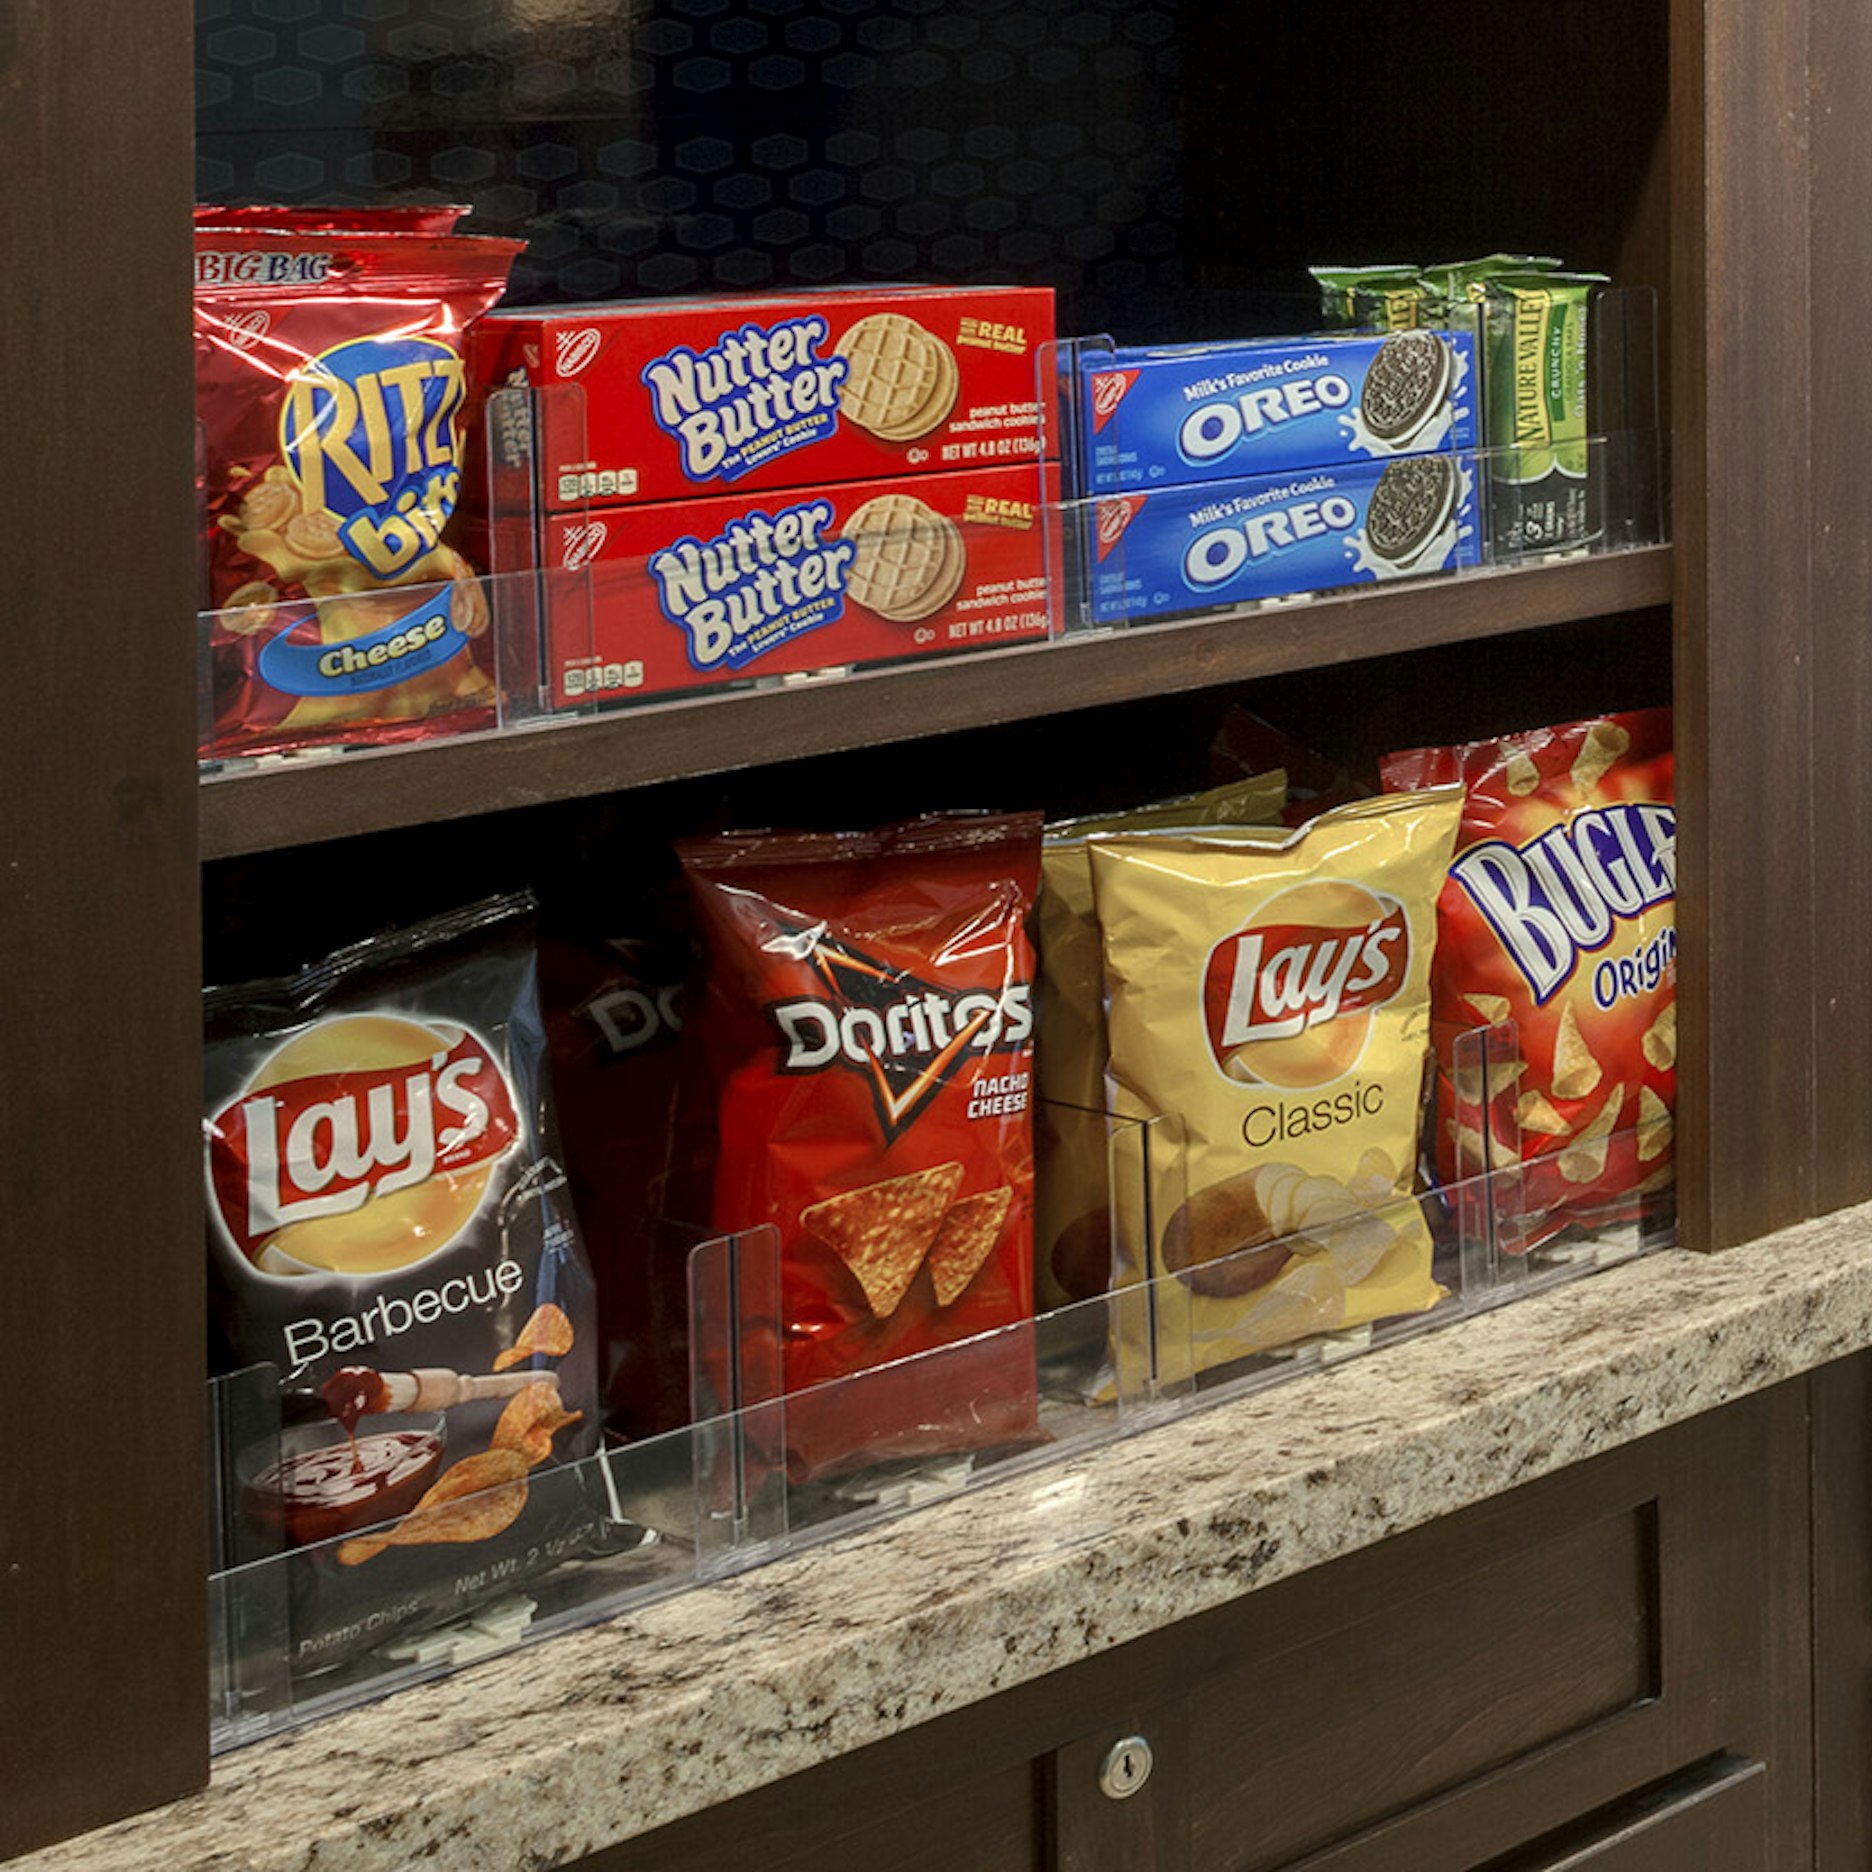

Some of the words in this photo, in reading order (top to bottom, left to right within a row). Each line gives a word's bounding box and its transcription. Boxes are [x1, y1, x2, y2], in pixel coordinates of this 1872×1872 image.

[196, 251, 264, 284] BIG
[267, 250, 332, 284] BAG
[977, 321, 1028, 346] REAL
[1517, 291, 1546, 365] VALLEY
[1550, 325, 1562, 399] CRUNCHY
[649, 319, 823, 426] Nutter
[1183, 377, 1227, 402] Milk's
[1226, 364, 1284, 388] Favorite
[1283, 353, 1329, 373] Cookie
[1516, 364, 1547, 442] NATURE
[294, 358, 467, 516] RITZ
[679, 359, 848, 480] Butter
[785, 414, 829, 435] BUTTER
[949, 418, 1002, 433] sandwich
[968, 402, 1008, 420] peanut
[1181, 374, 1351, 459] OREO
[942, 445, 960, 461] NET
[961, 443, 977, 460] WT
[984, 499, 1033, 519] REAL
[1188, 504, 1233, 528] Milk's
[1232, 489, 1290, 512] Favorite
[1289, 477, 1336, 497] Cookie
[655, 503, 829, 615] Nutter
[1186, 496, 1357, 583] OREO
[686, 541, 854, 668] Butter
[318, 614, 447, 678] Cheese
[1453, 804, 1676, 1004] BUGLE
[1221, 916, 1402, 1049] Lay's
[775, 985, 1032, 1070] Doritos
[967, 1092, 1029, 1119] CHEESE
[973, 1073, 1029, 1099] NACHO
[1242, 1082, 1385, 1150] Classic
[242, 1048, 492, 1238] Lay's
[284, 1257, 526, 1366] Barbecue
[455, 1571, 487, 1596] Net
[299, 1626, 362, 1659] Potato
[366, 1599, 420, 1633] Chips
